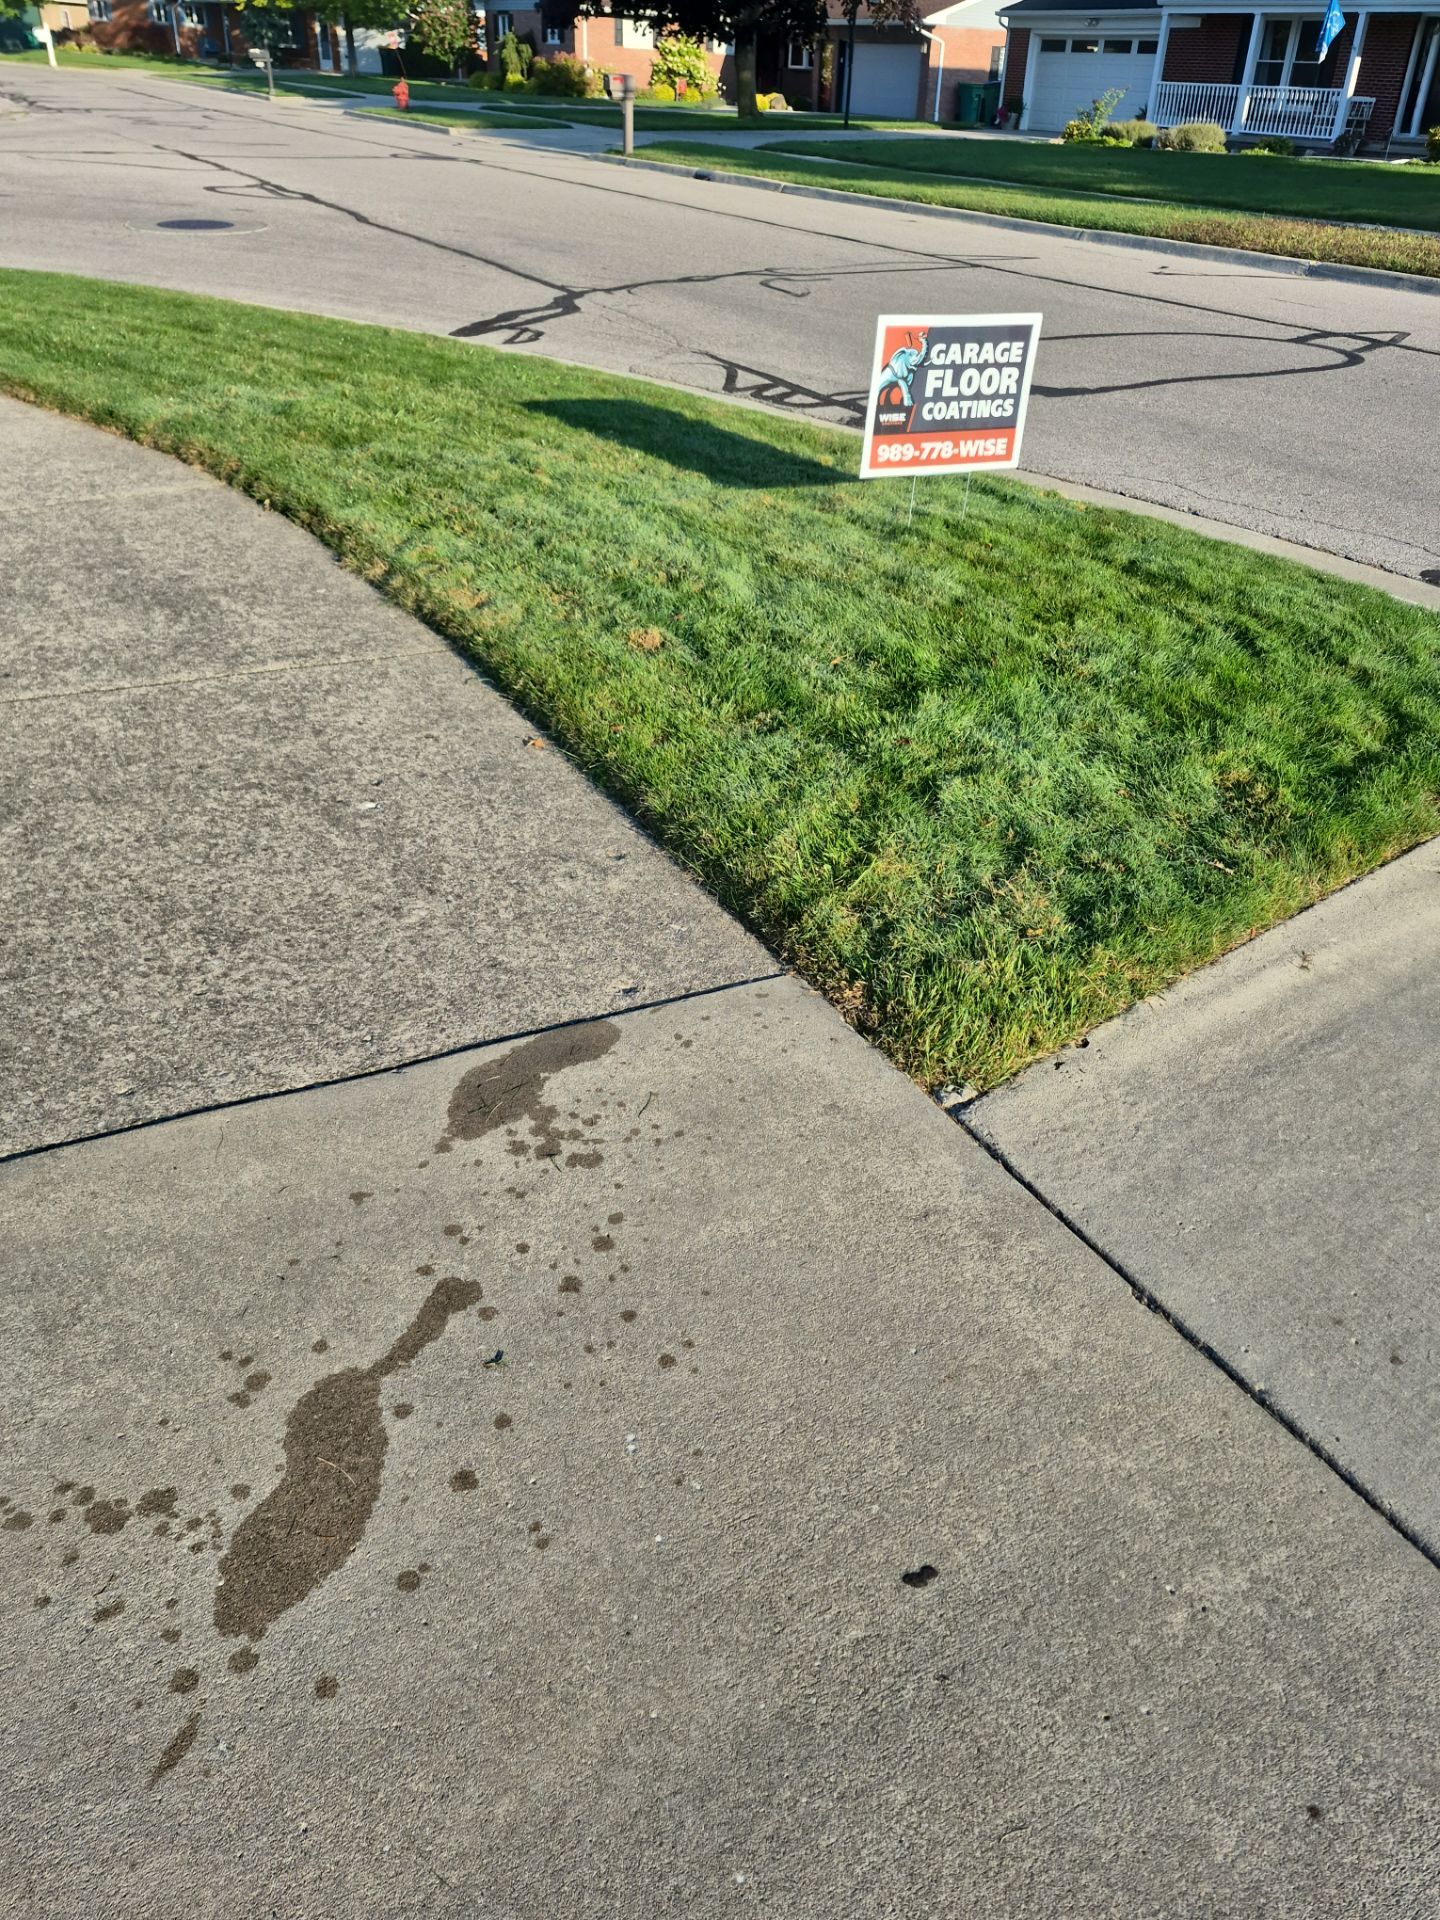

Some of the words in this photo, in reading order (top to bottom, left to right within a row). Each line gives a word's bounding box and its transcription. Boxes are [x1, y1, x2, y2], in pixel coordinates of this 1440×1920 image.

[930, 341, 1025, 365] GARAGE
[924, 366, 1020, 397] FLOOR
[879, 412, 907, 422] WISE
[922, 398, 1015, 421] COATINGS
[877, 438, 1008, 463] 989-778-WISE
